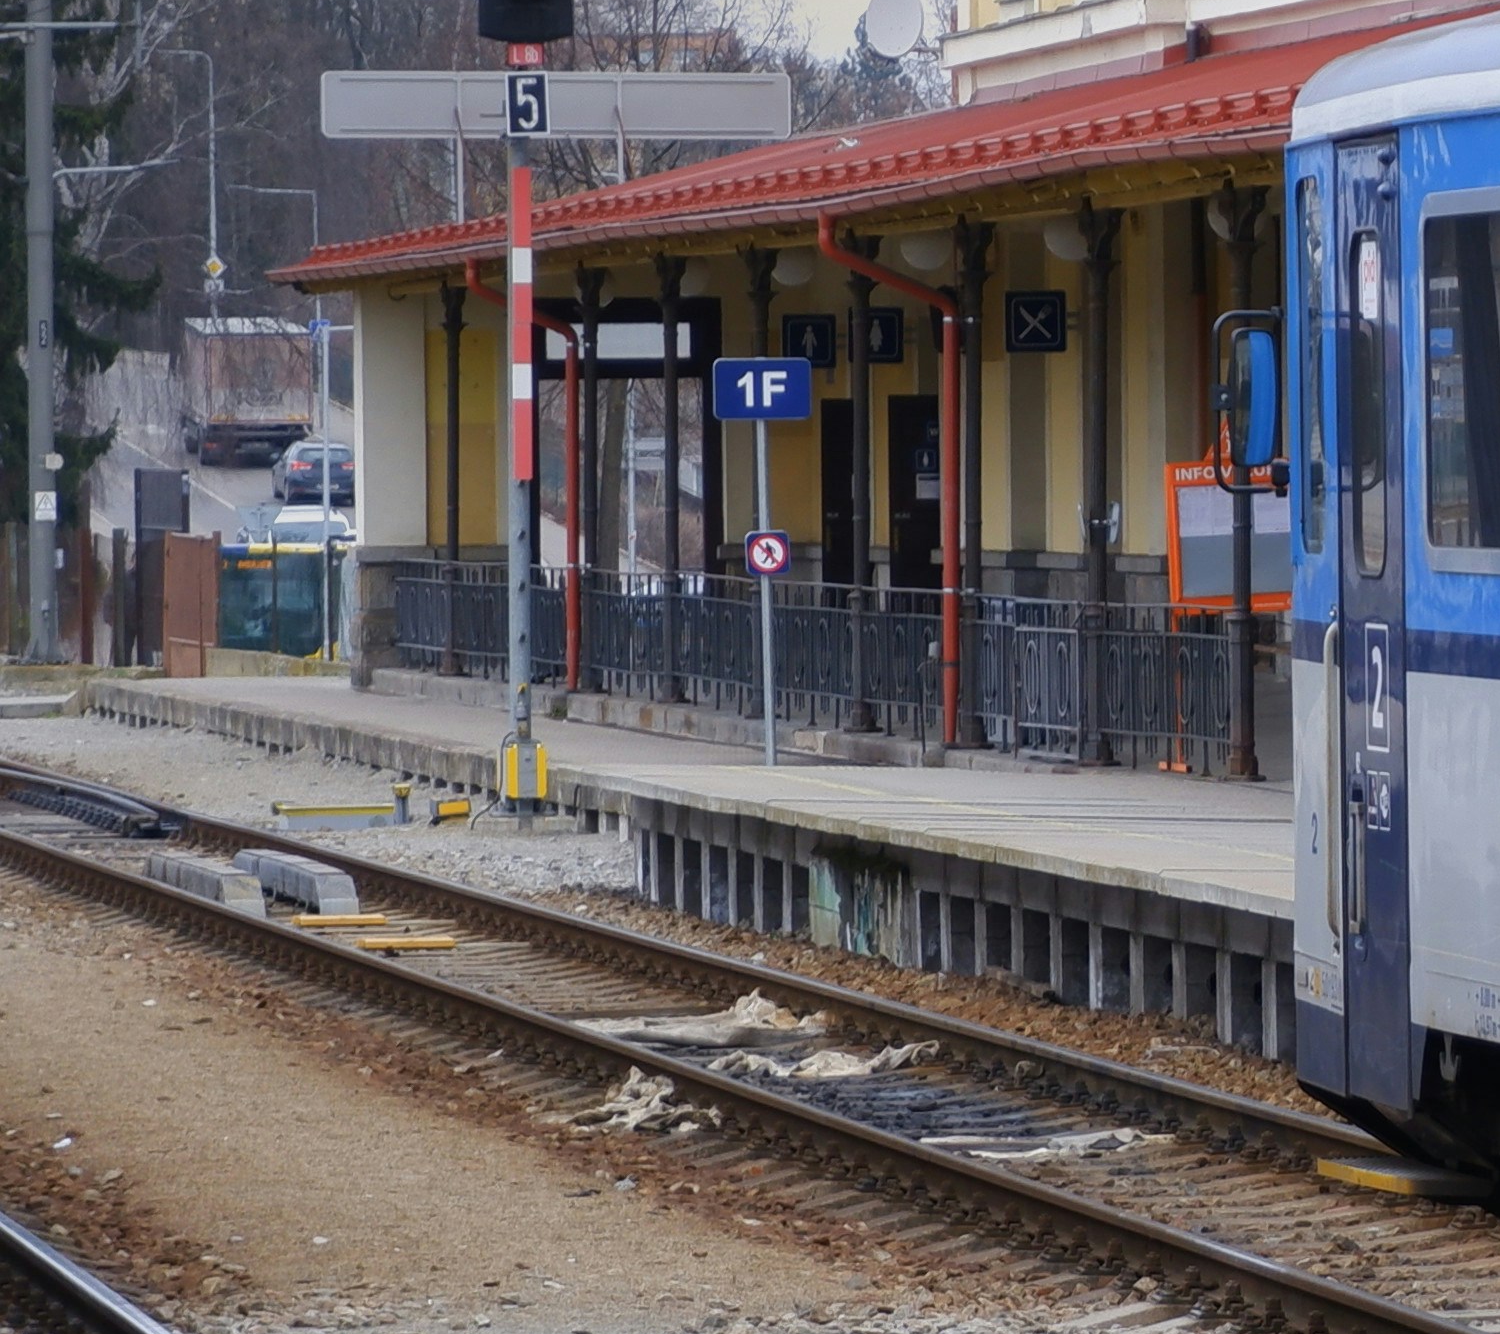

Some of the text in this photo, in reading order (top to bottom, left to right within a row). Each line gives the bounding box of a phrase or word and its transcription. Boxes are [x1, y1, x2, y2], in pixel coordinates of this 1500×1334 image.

[516, 77, 539, 130] 5
[737, 370, 788, 408] 1F
[1175, 466, 1215, 482] INFO
[1371, 645, 1385, 729] 2
